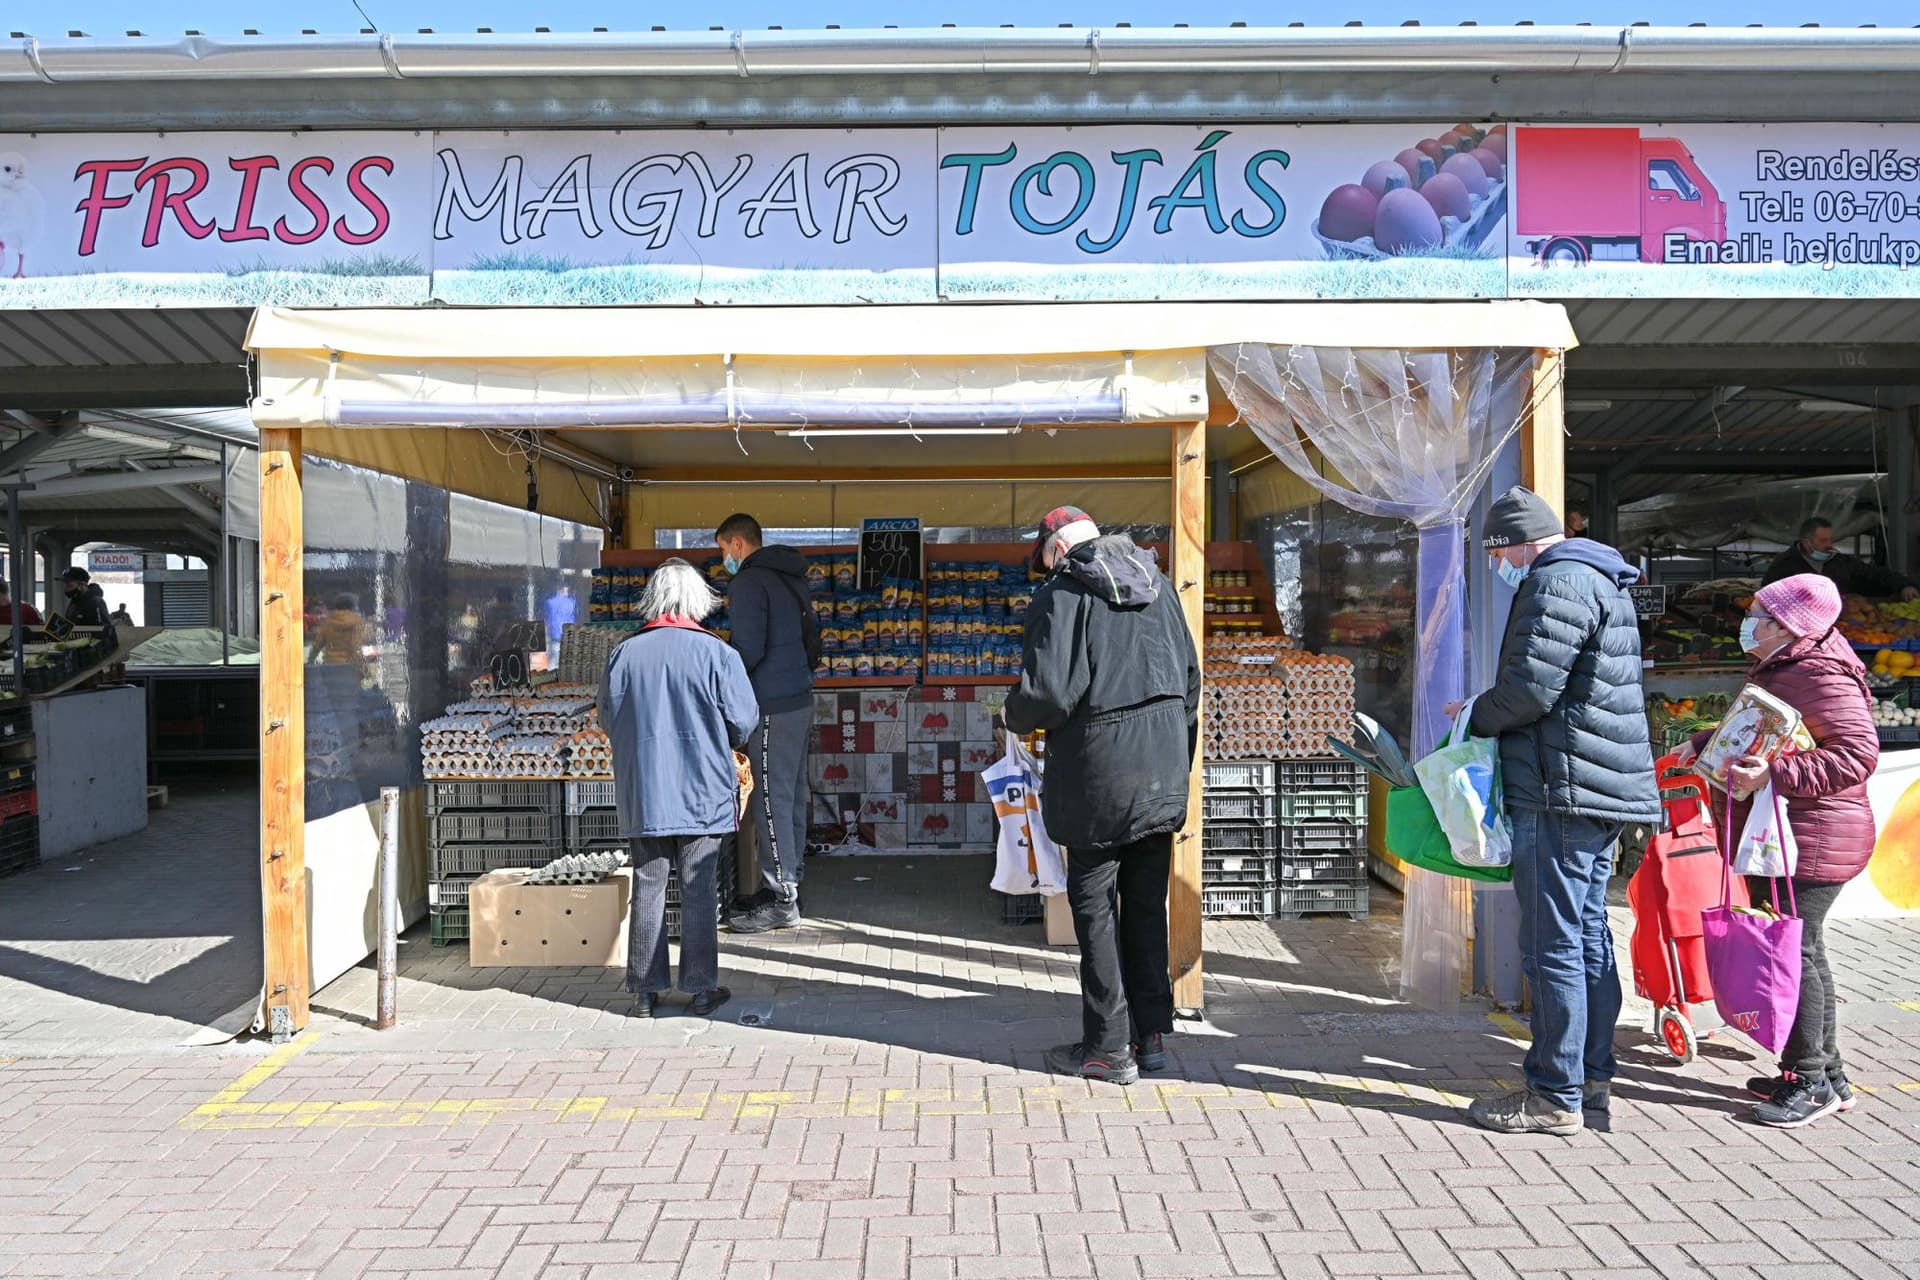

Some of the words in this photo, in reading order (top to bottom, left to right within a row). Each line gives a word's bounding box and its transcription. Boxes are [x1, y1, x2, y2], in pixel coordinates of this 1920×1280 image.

[1757, 149, 1920, 181] Rendelés
[74, 155, 394, 256] FRISS
[433, 148, 907, 249] MAGYAR
[940, 130, 1291, 254] TOJÁS
[1739, 191, 1804, 222] Tel:
[1663, 232, 1773, 264] Email:
